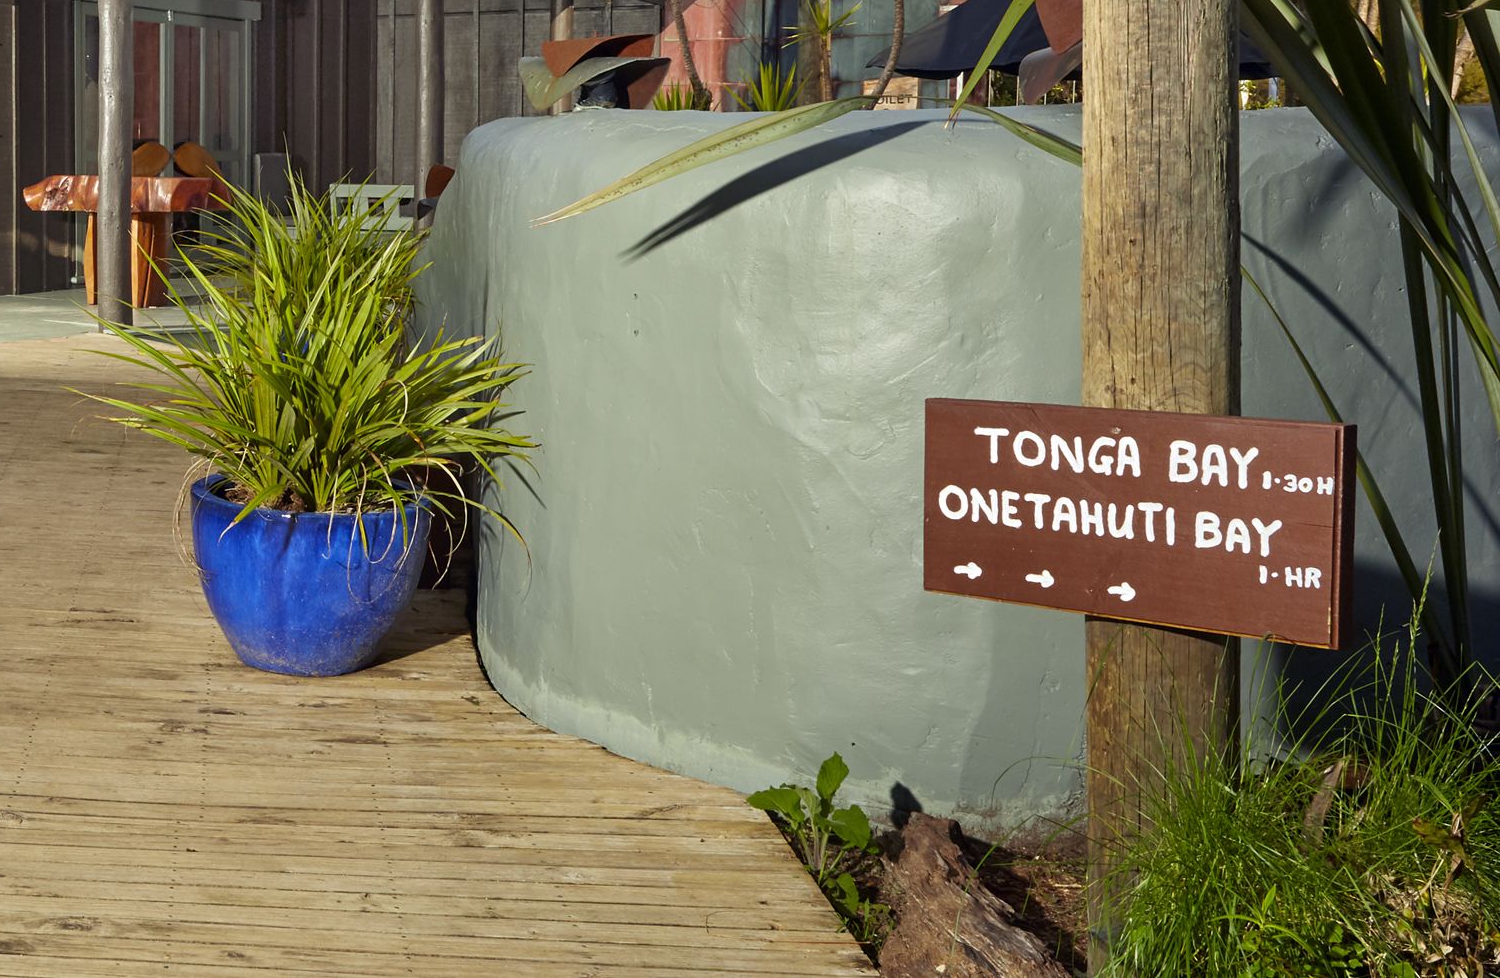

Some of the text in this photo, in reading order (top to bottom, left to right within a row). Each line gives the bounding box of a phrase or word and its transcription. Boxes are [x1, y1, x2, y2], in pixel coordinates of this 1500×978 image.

[974, 426, 1141, 477] TONGA
[1169, 439, 1259, 490] BAY
[938, 484, 1283, 558] ONETAHUTI BAY
